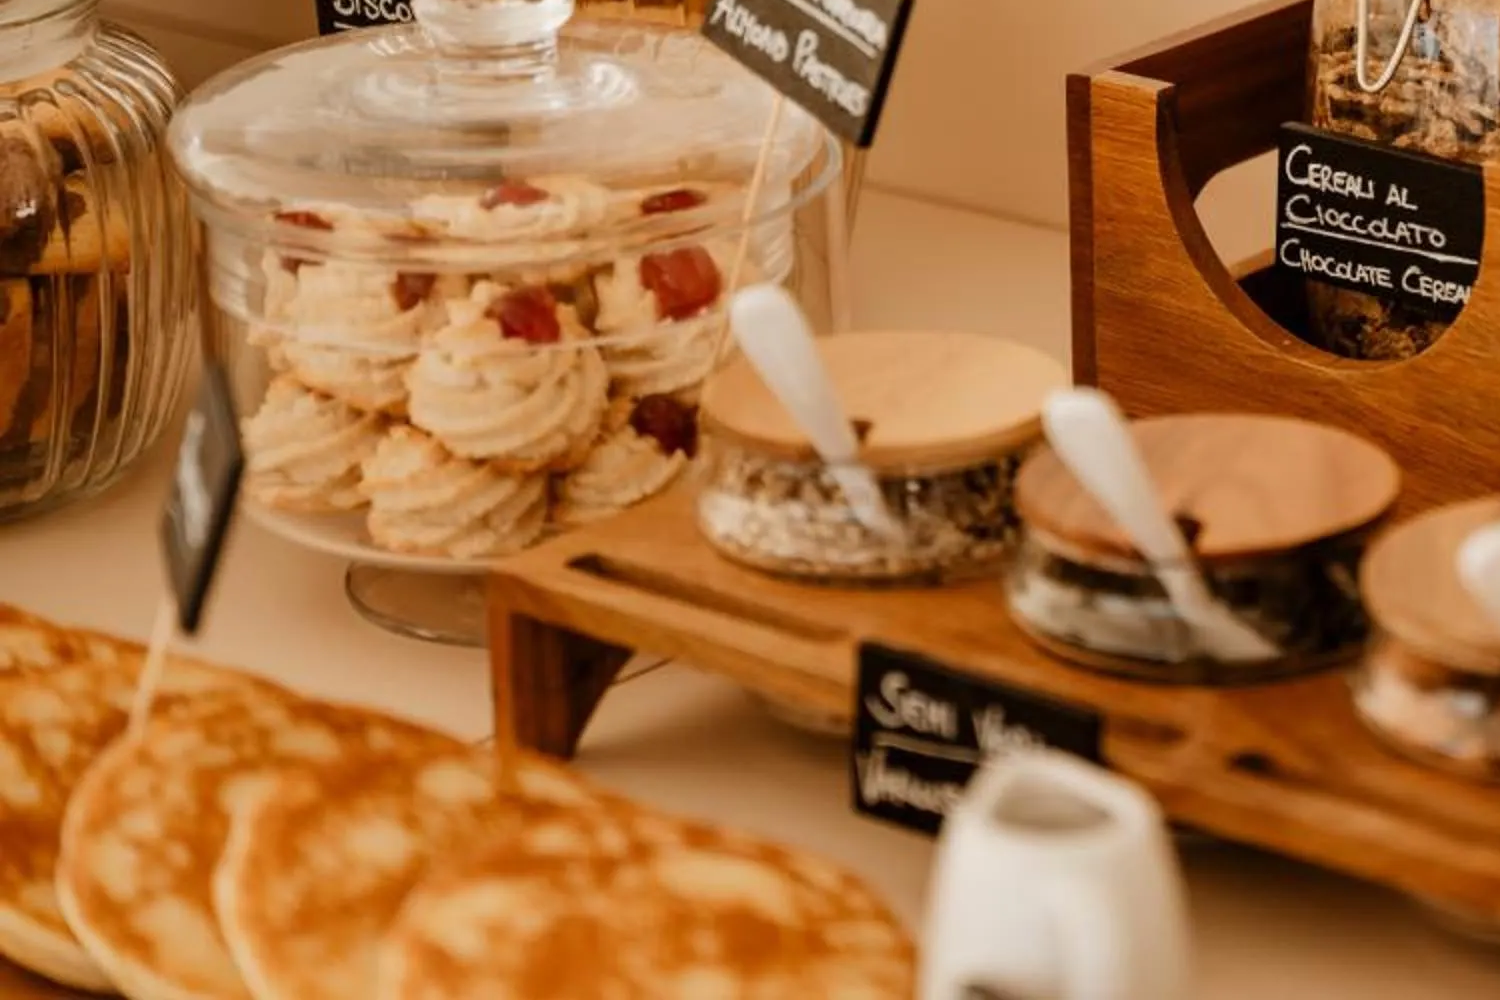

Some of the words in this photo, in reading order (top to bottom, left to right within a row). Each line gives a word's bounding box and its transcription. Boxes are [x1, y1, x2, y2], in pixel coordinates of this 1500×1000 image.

[1285, 144, 1375, 199] CEREALI
[1385, 183, 1418, 210] AL
[1284, 194, 1446, 248] CIOCCOLATO
[1280, 238, 1393, 288] CHOCOLATE
